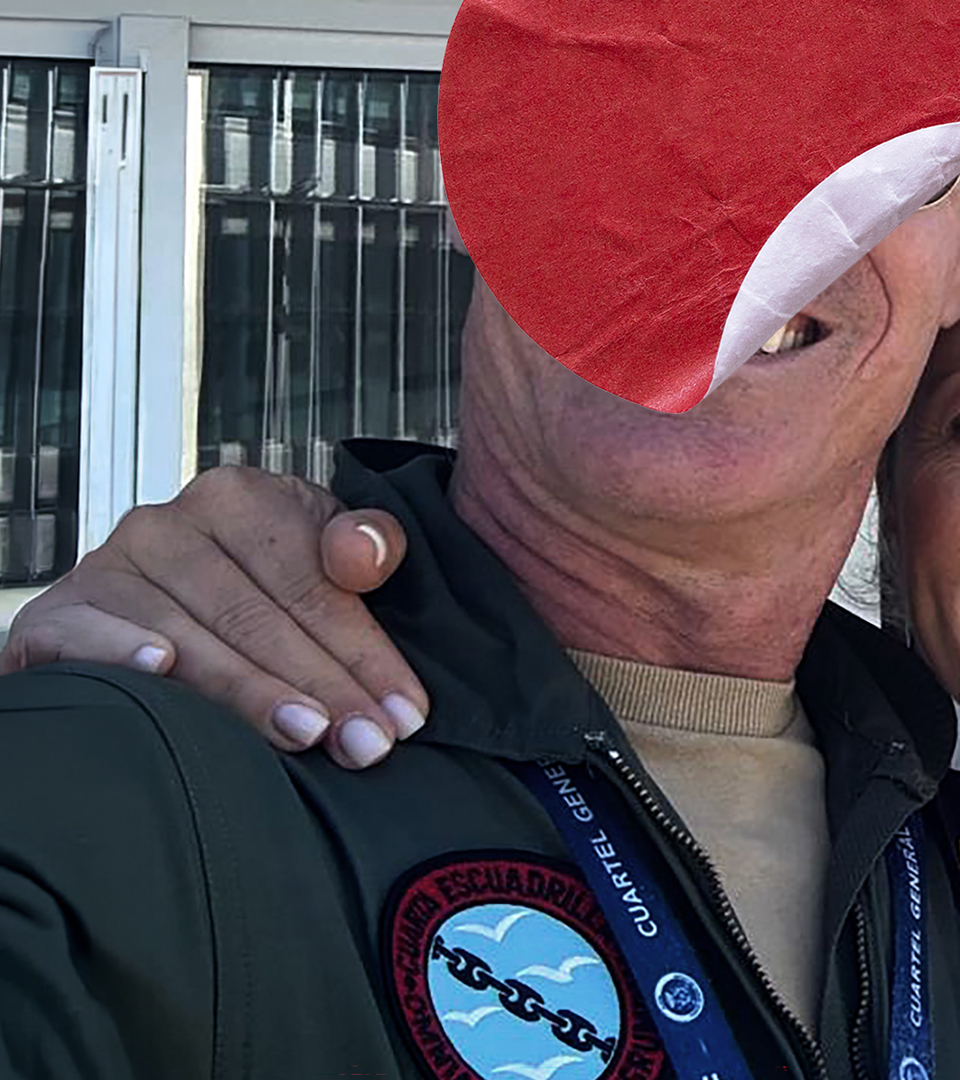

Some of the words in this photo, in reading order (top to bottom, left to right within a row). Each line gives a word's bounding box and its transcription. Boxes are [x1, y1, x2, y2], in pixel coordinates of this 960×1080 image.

[592, 829, 658, 938] CUARTEL
[895, 826, 922, 920] GENERAL
[906, 929, 922, 1027] CUARTEL
